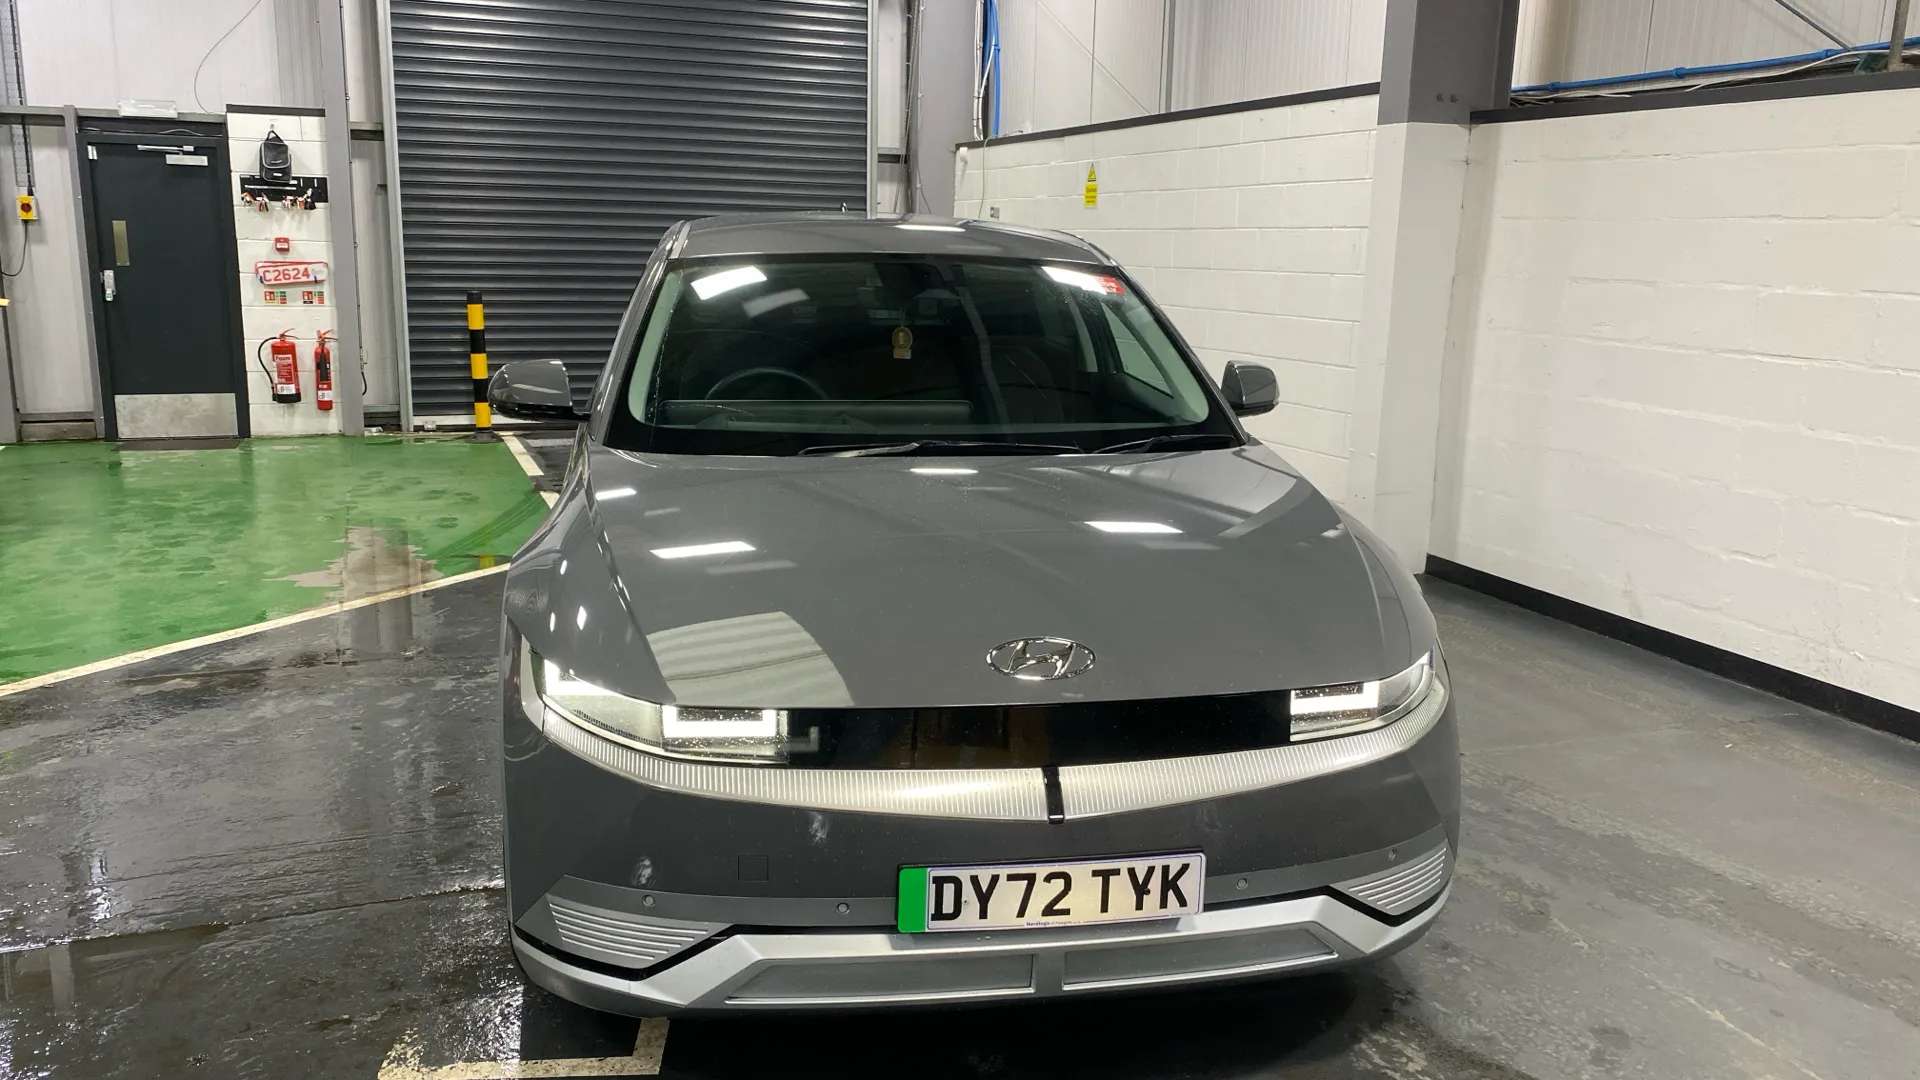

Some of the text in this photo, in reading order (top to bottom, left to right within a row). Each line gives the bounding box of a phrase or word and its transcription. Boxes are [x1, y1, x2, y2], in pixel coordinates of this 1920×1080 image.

[263, 267, 310, 282] C2624
[930, 863, 1191, 922] DY72 TYK
